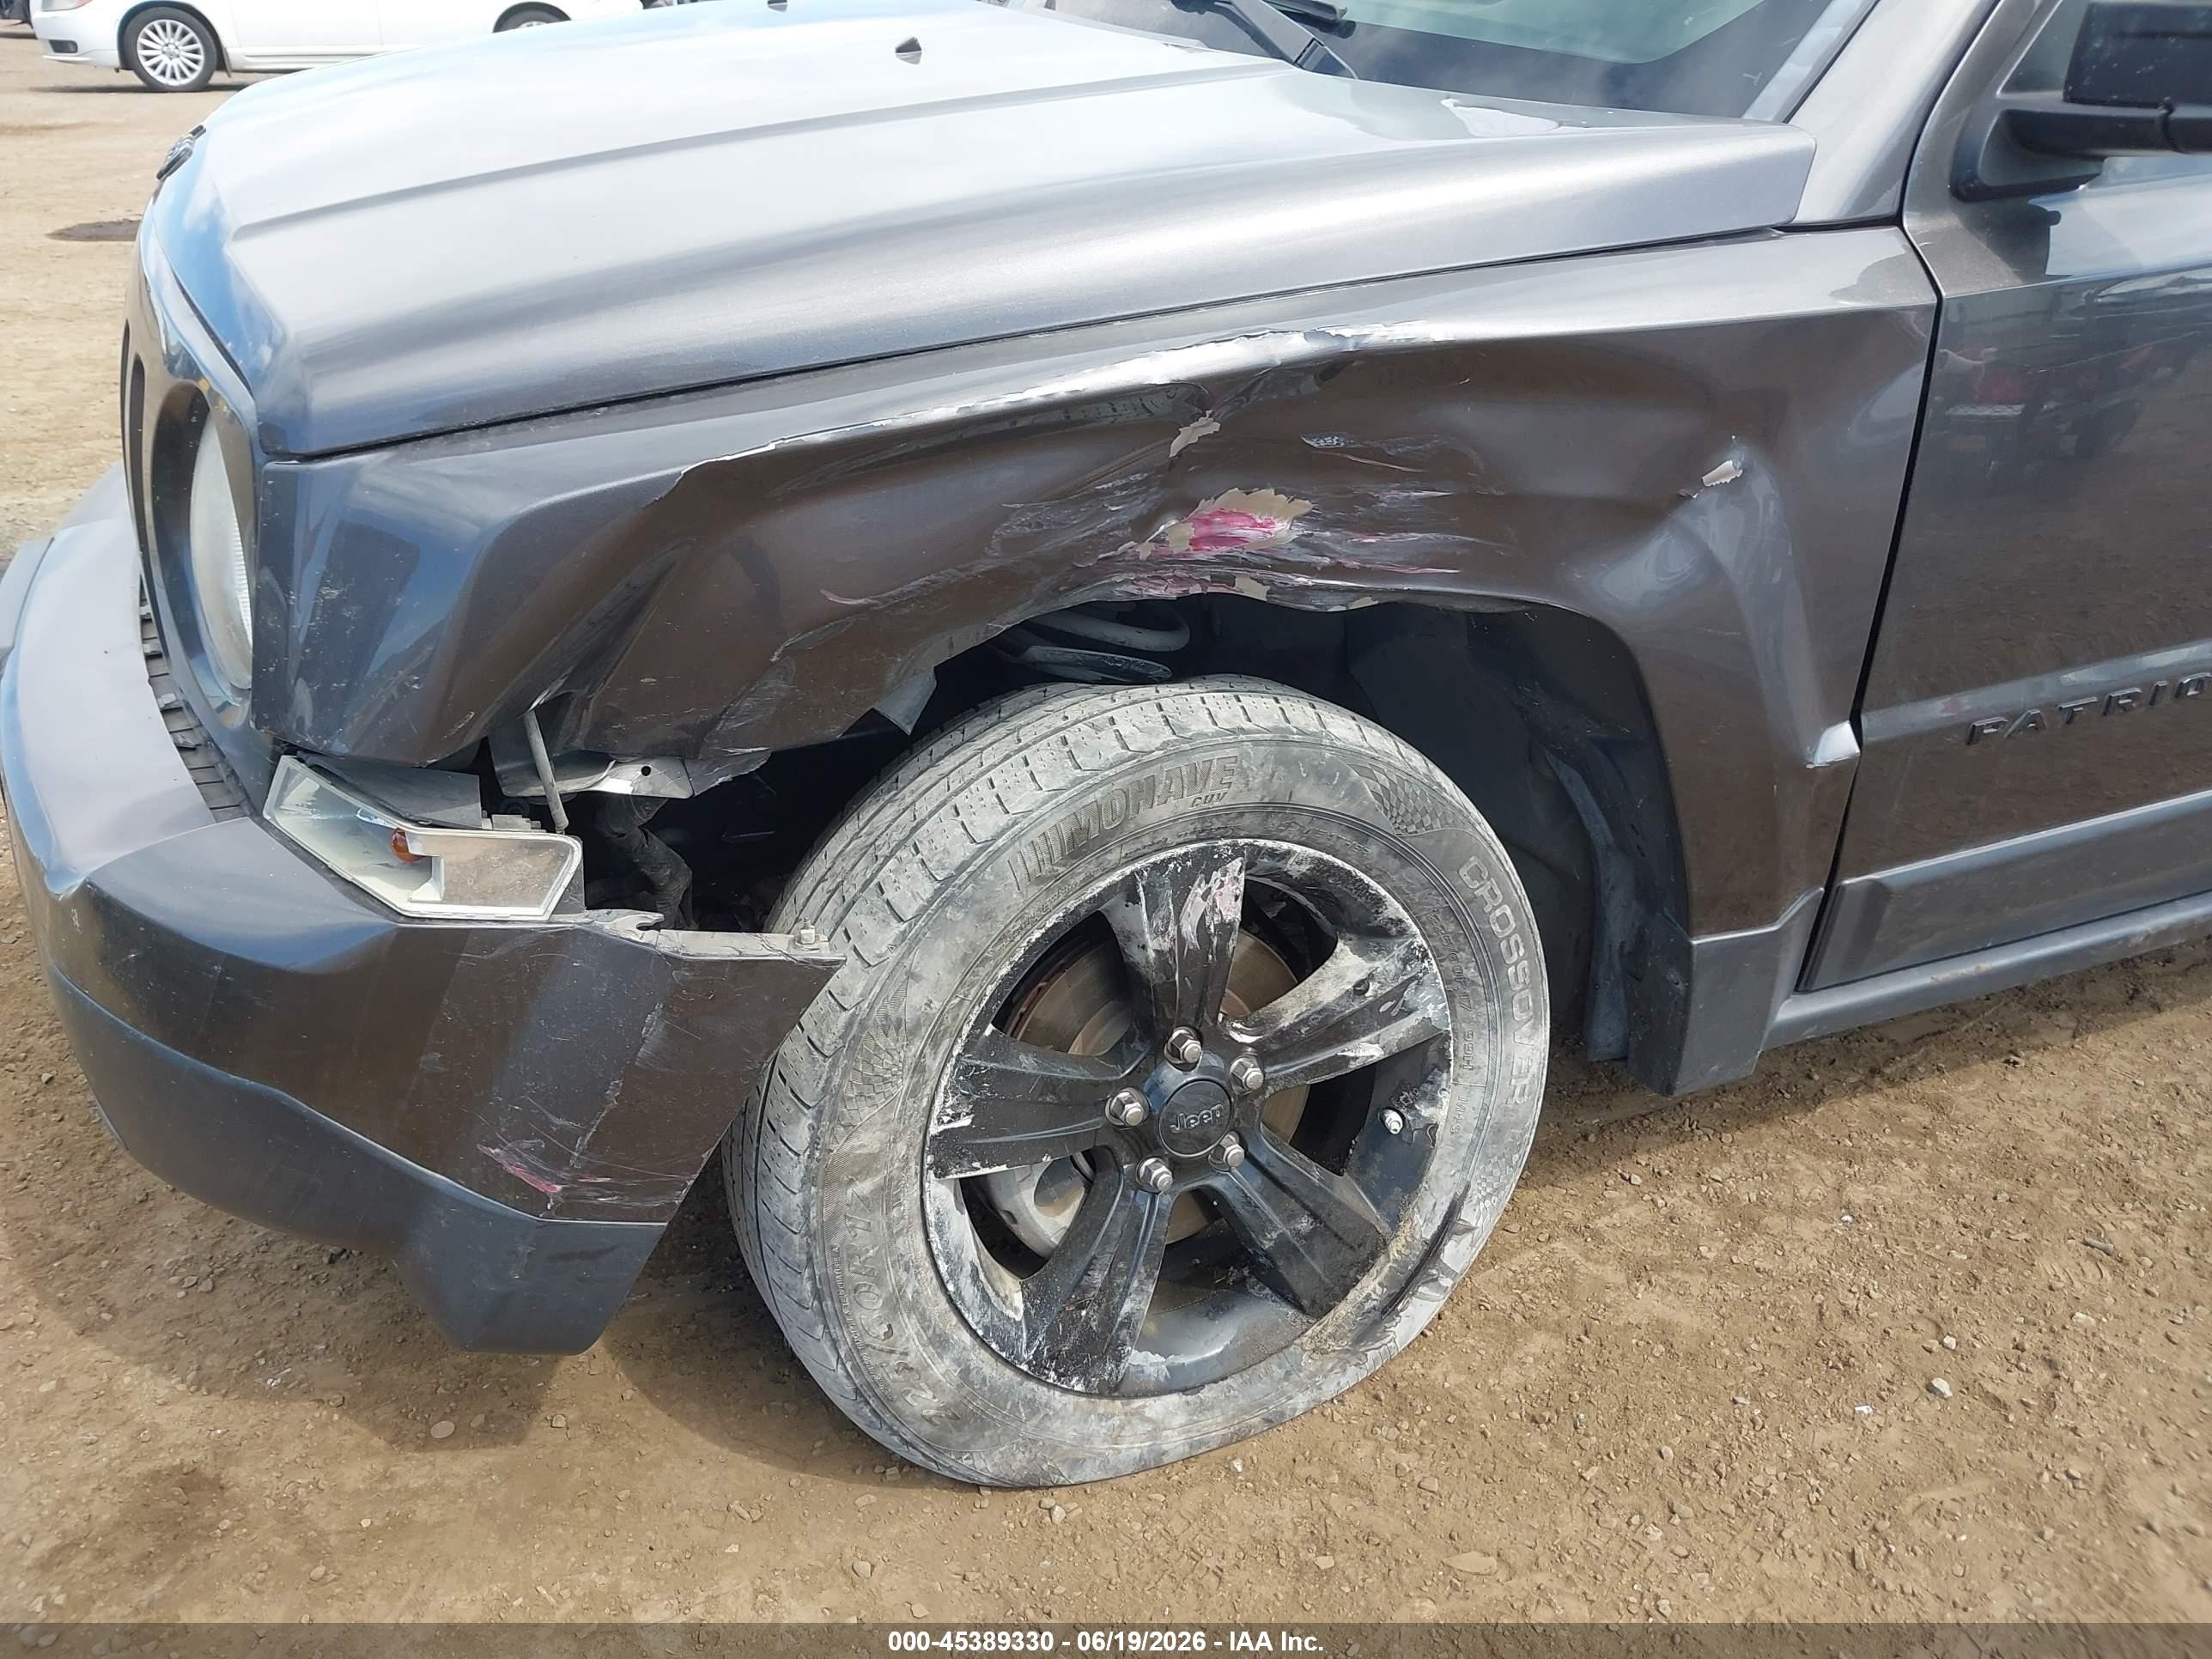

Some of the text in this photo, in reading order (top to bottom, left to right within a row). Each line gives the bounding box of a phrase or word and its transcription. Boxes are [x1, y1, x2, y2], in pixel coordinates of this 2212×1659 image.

[1057, 756, 1237, 855] MOHAVE
[1459, 855, 1534, 1105] CROSSOVER
[1462, 1030, 1474, 1070] 99H
[1170, 1104, 1224, 1133] Jeep
